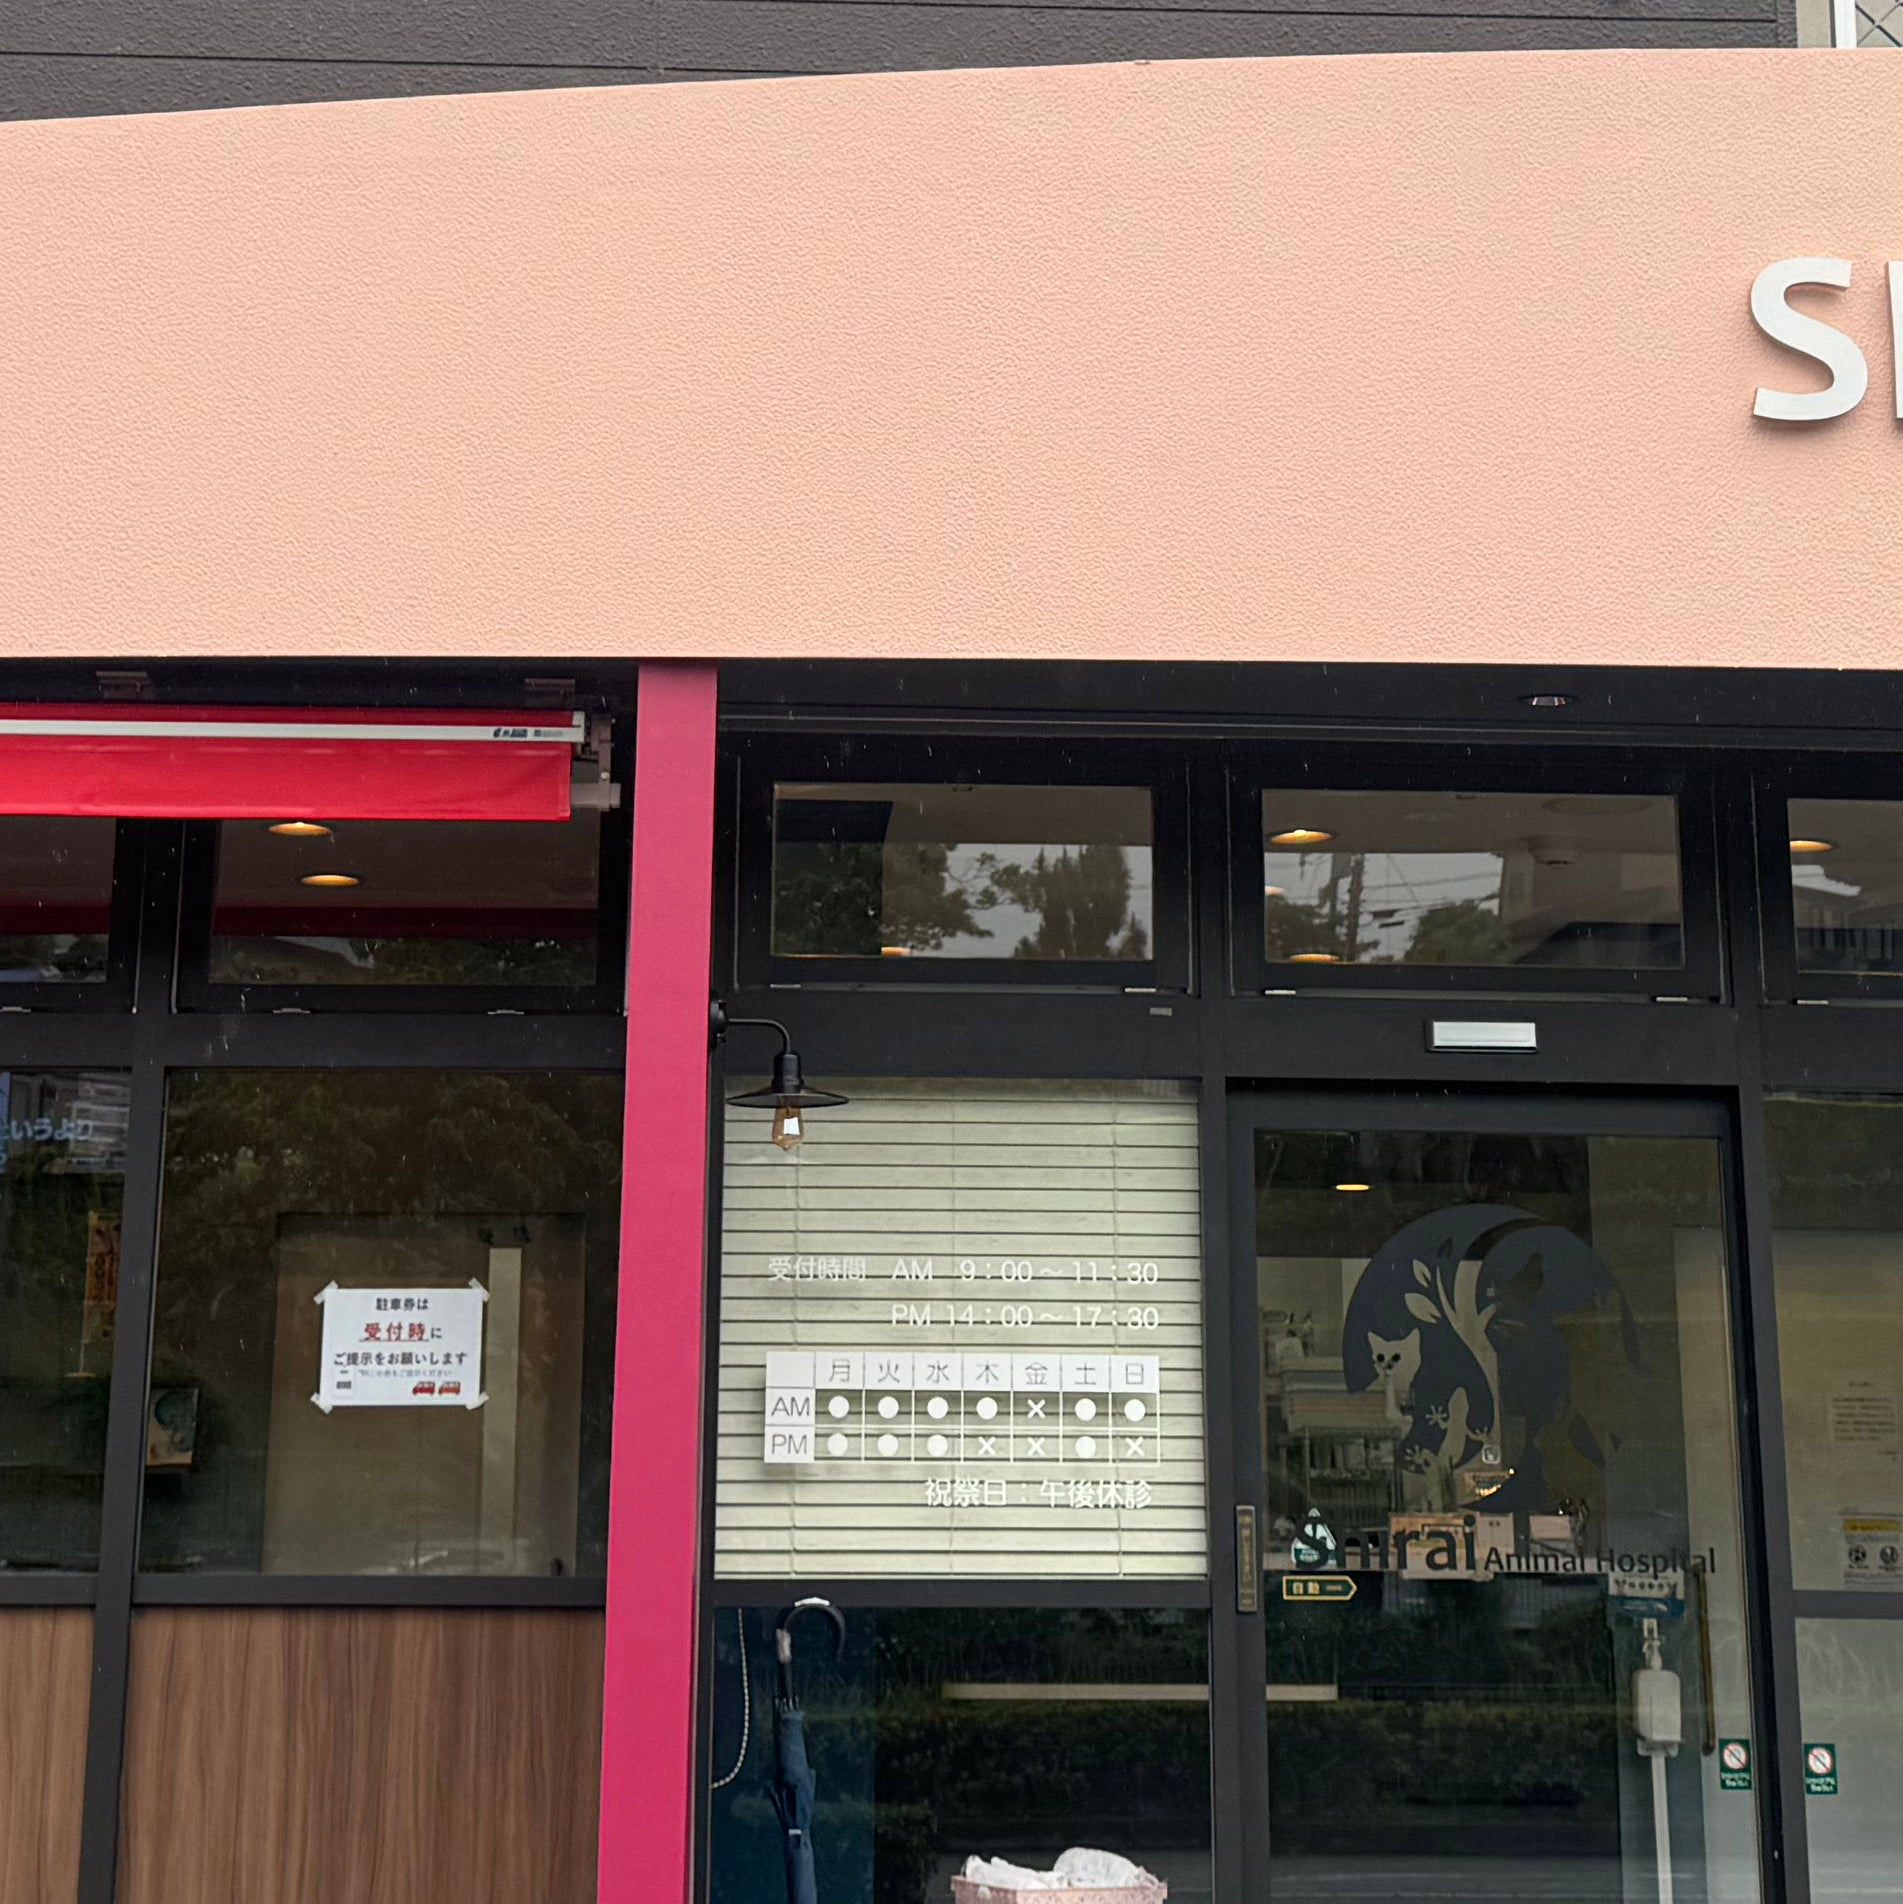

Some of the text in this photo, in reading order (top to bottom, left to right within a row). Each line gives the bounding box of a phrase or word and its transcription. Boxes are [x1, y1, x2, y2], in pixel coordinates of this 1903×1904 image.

[768, 1257, 867, 1282] 受付時間
[891, 1259, 934, 1283] AM
[376, 1298, 428, 1312] 駐車券は
[891, 1305, 932, 1328] PM
[827, 1358, 1145, 1386] 月 火 水 木 金 土 日
[770, 1396, 811, 1417] AM
[770, 1434, 808, 1455] PM
[1484, 1546, 1585, 1572] Animal
[1596, 1547, 1716, 1581] Hospital
